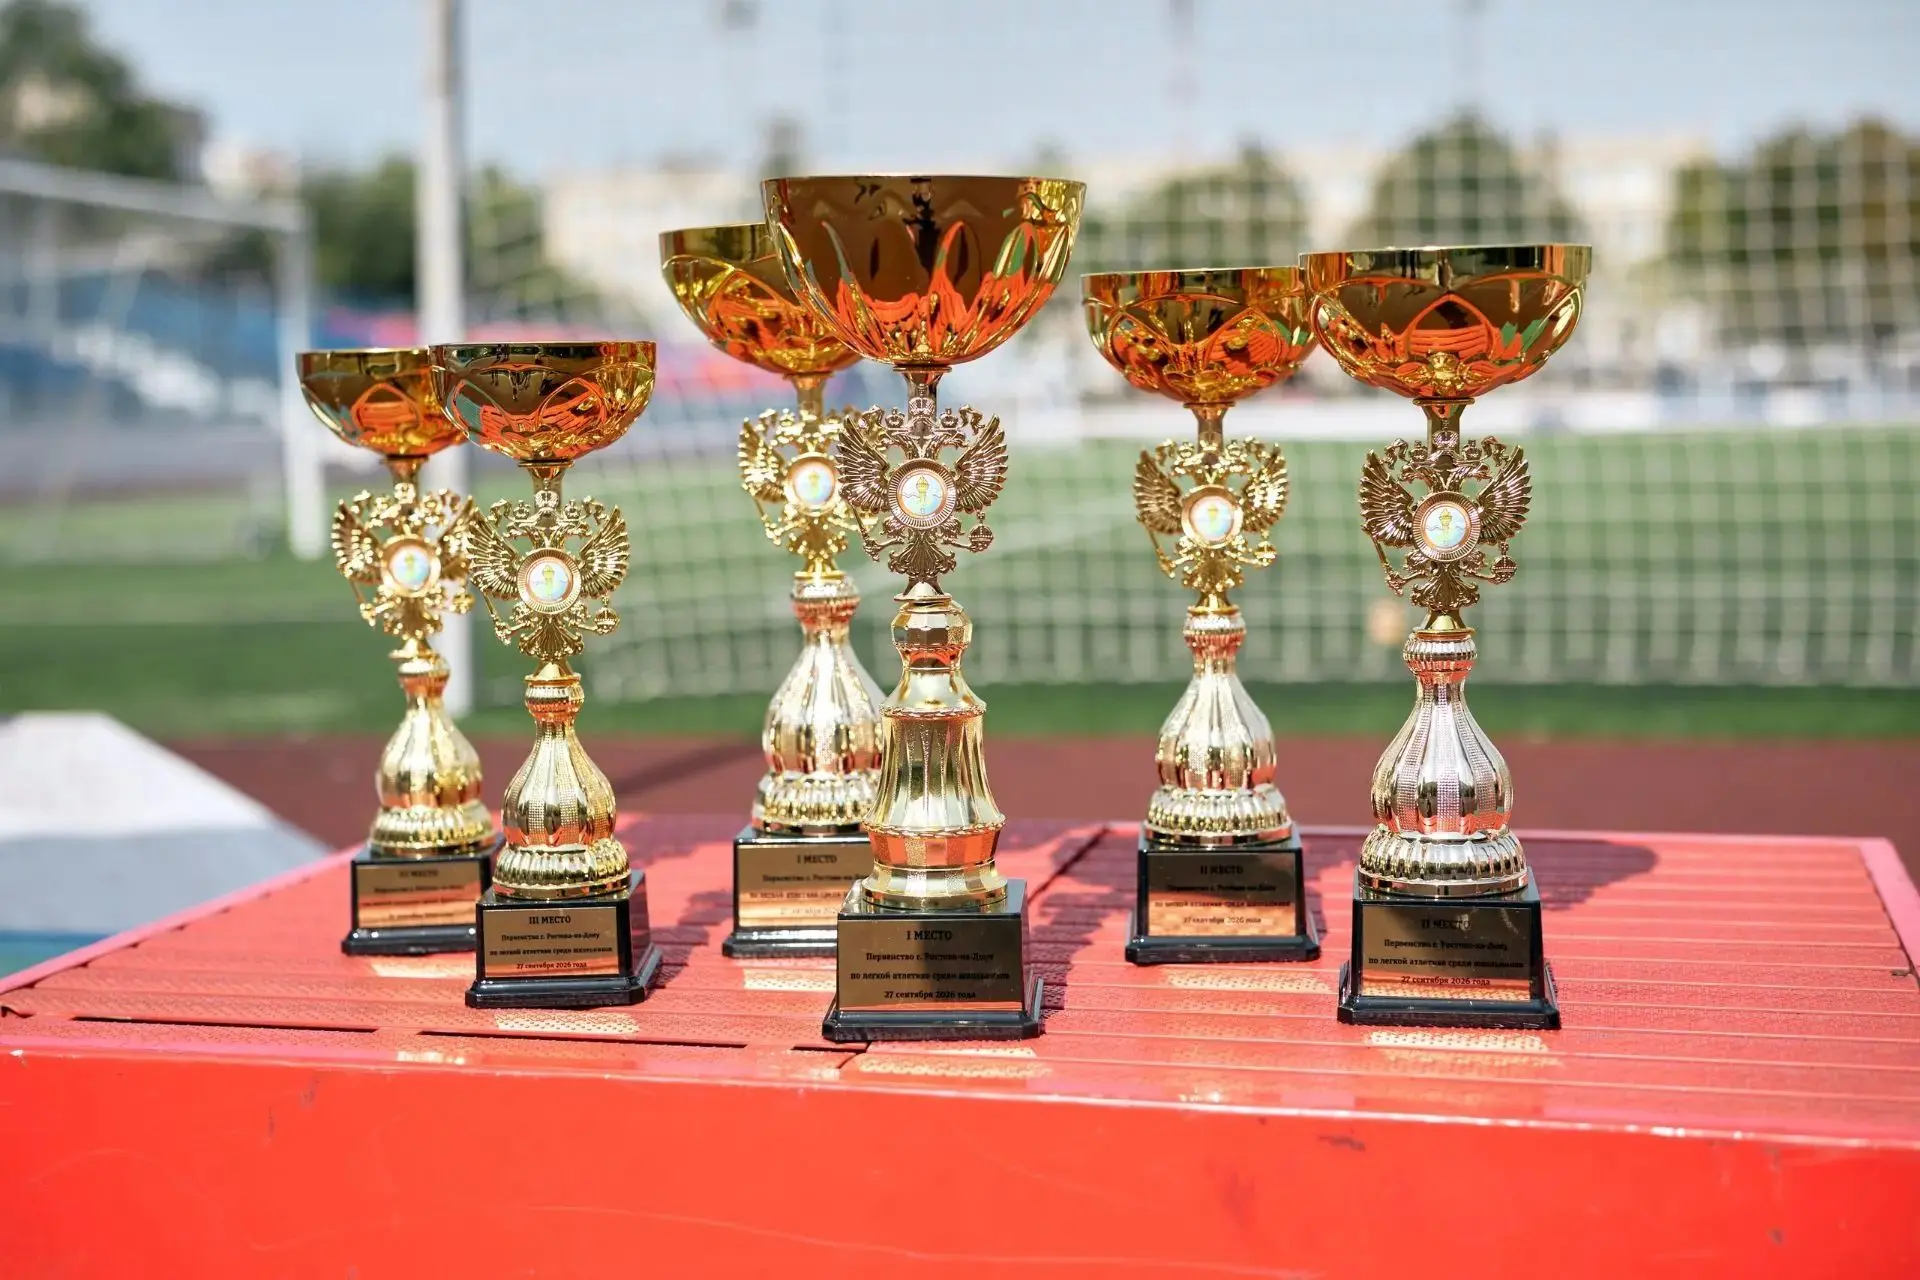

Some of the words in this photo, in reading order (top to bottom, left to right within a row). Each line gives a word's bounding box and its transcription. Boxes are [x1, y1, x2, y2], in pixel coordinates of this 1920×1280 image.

[804, 855, 837, 864] МЕСТО
[1210, 865, 1244, 875] МЕСТО
[529, 916, 539, 924] III
[541, 916, 571, 924] МЕСТО
[1422, 918, 1430, 929] II
[1433, 918, 1471, 930] МЕСТО
[906, 930, 911, 940] I
[914, 930, 952, 940] МЕСТО
[1384, 939, 1431, 949] Первенство
[866, 953, 914, 962] Первенство
[1380, 956, 1408, 965] легкой
[525, 962, 554, 970] сентября
[862, 970, 891, 979] легкой
[1412, 976, 1448, 985] сентября
[895, 989, 933, 999] сентября
